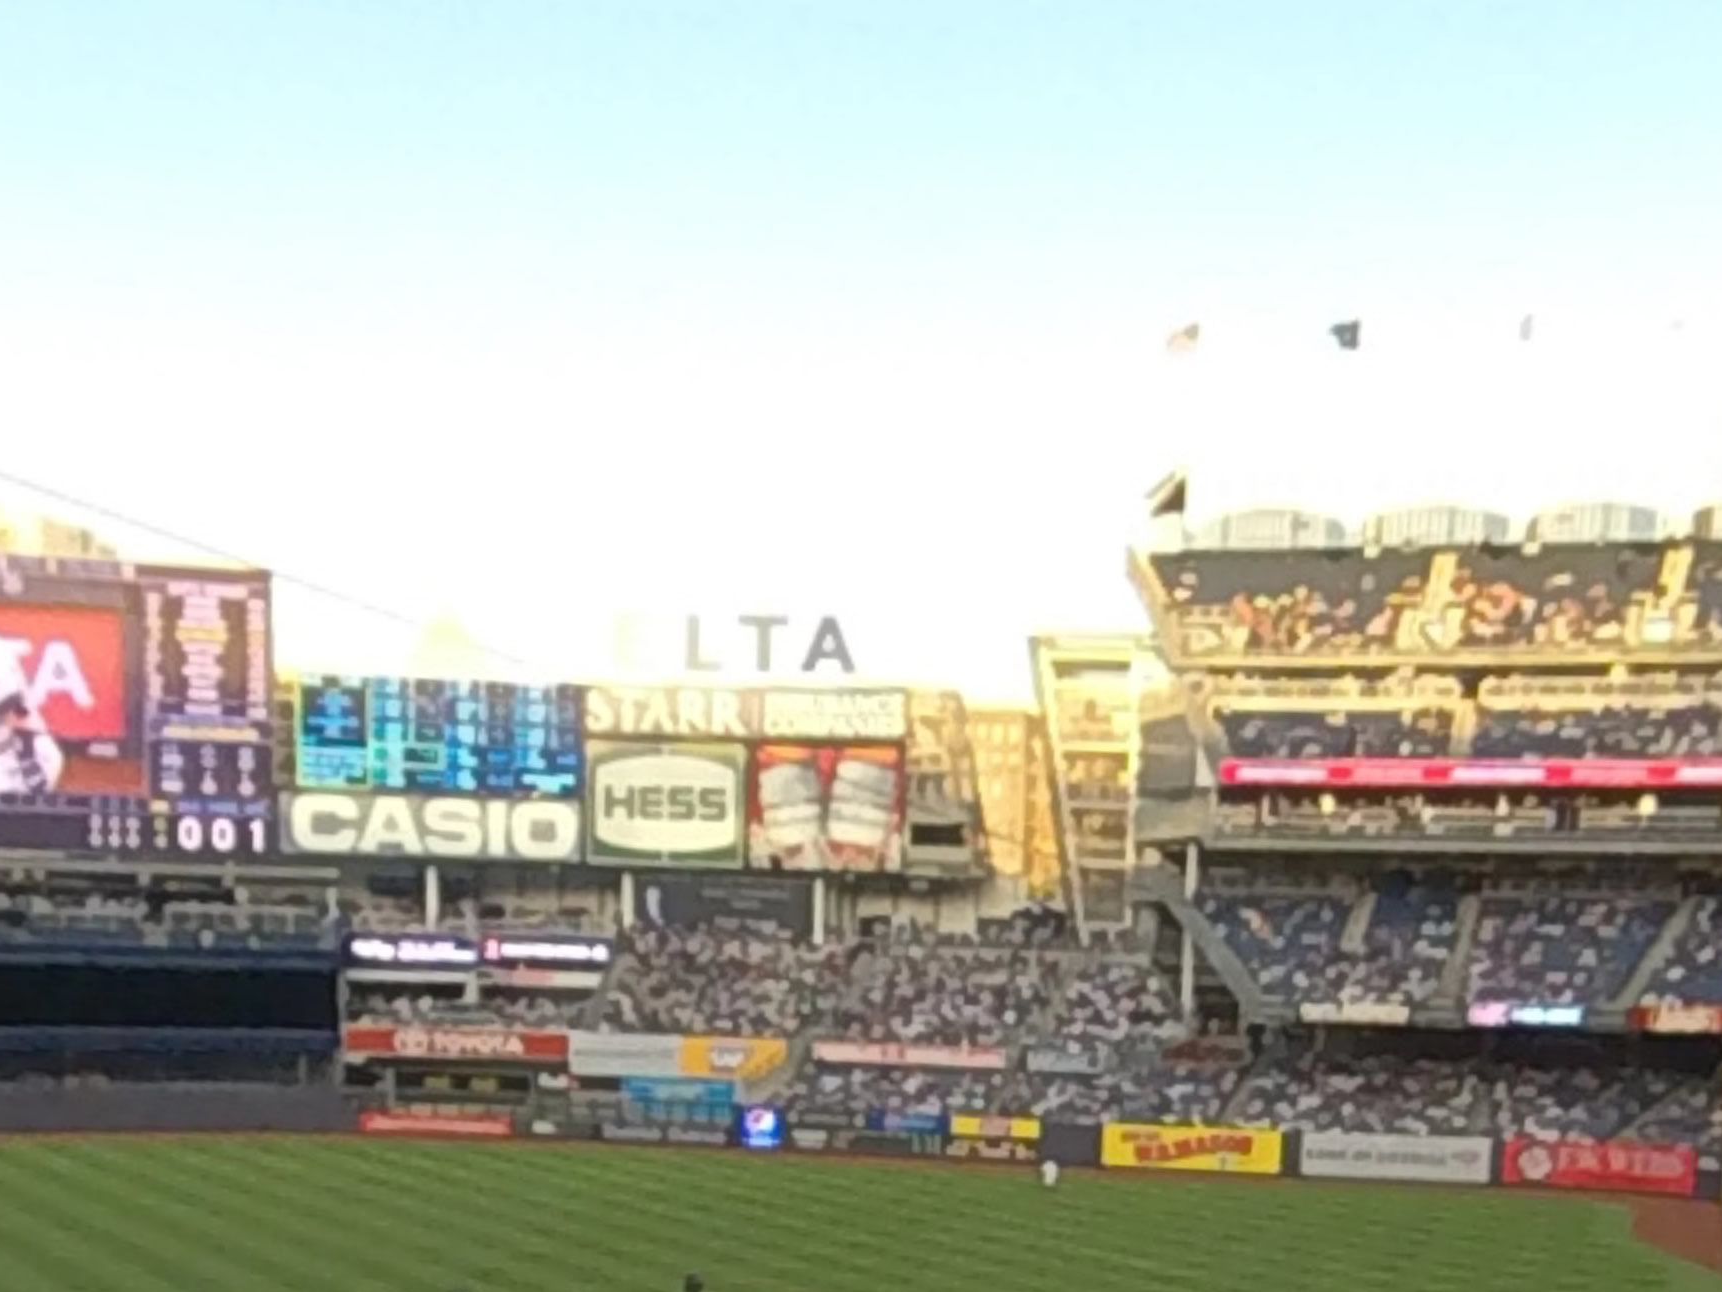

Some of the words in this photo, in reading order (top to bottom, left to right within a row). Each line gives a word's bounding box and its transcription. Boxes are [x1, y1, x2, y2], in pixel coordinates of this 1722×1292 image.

[585, 688, 747, 735] STARR
[291, 794, 575, 857] CASIO
[603, 785, 727, 822] HESS
